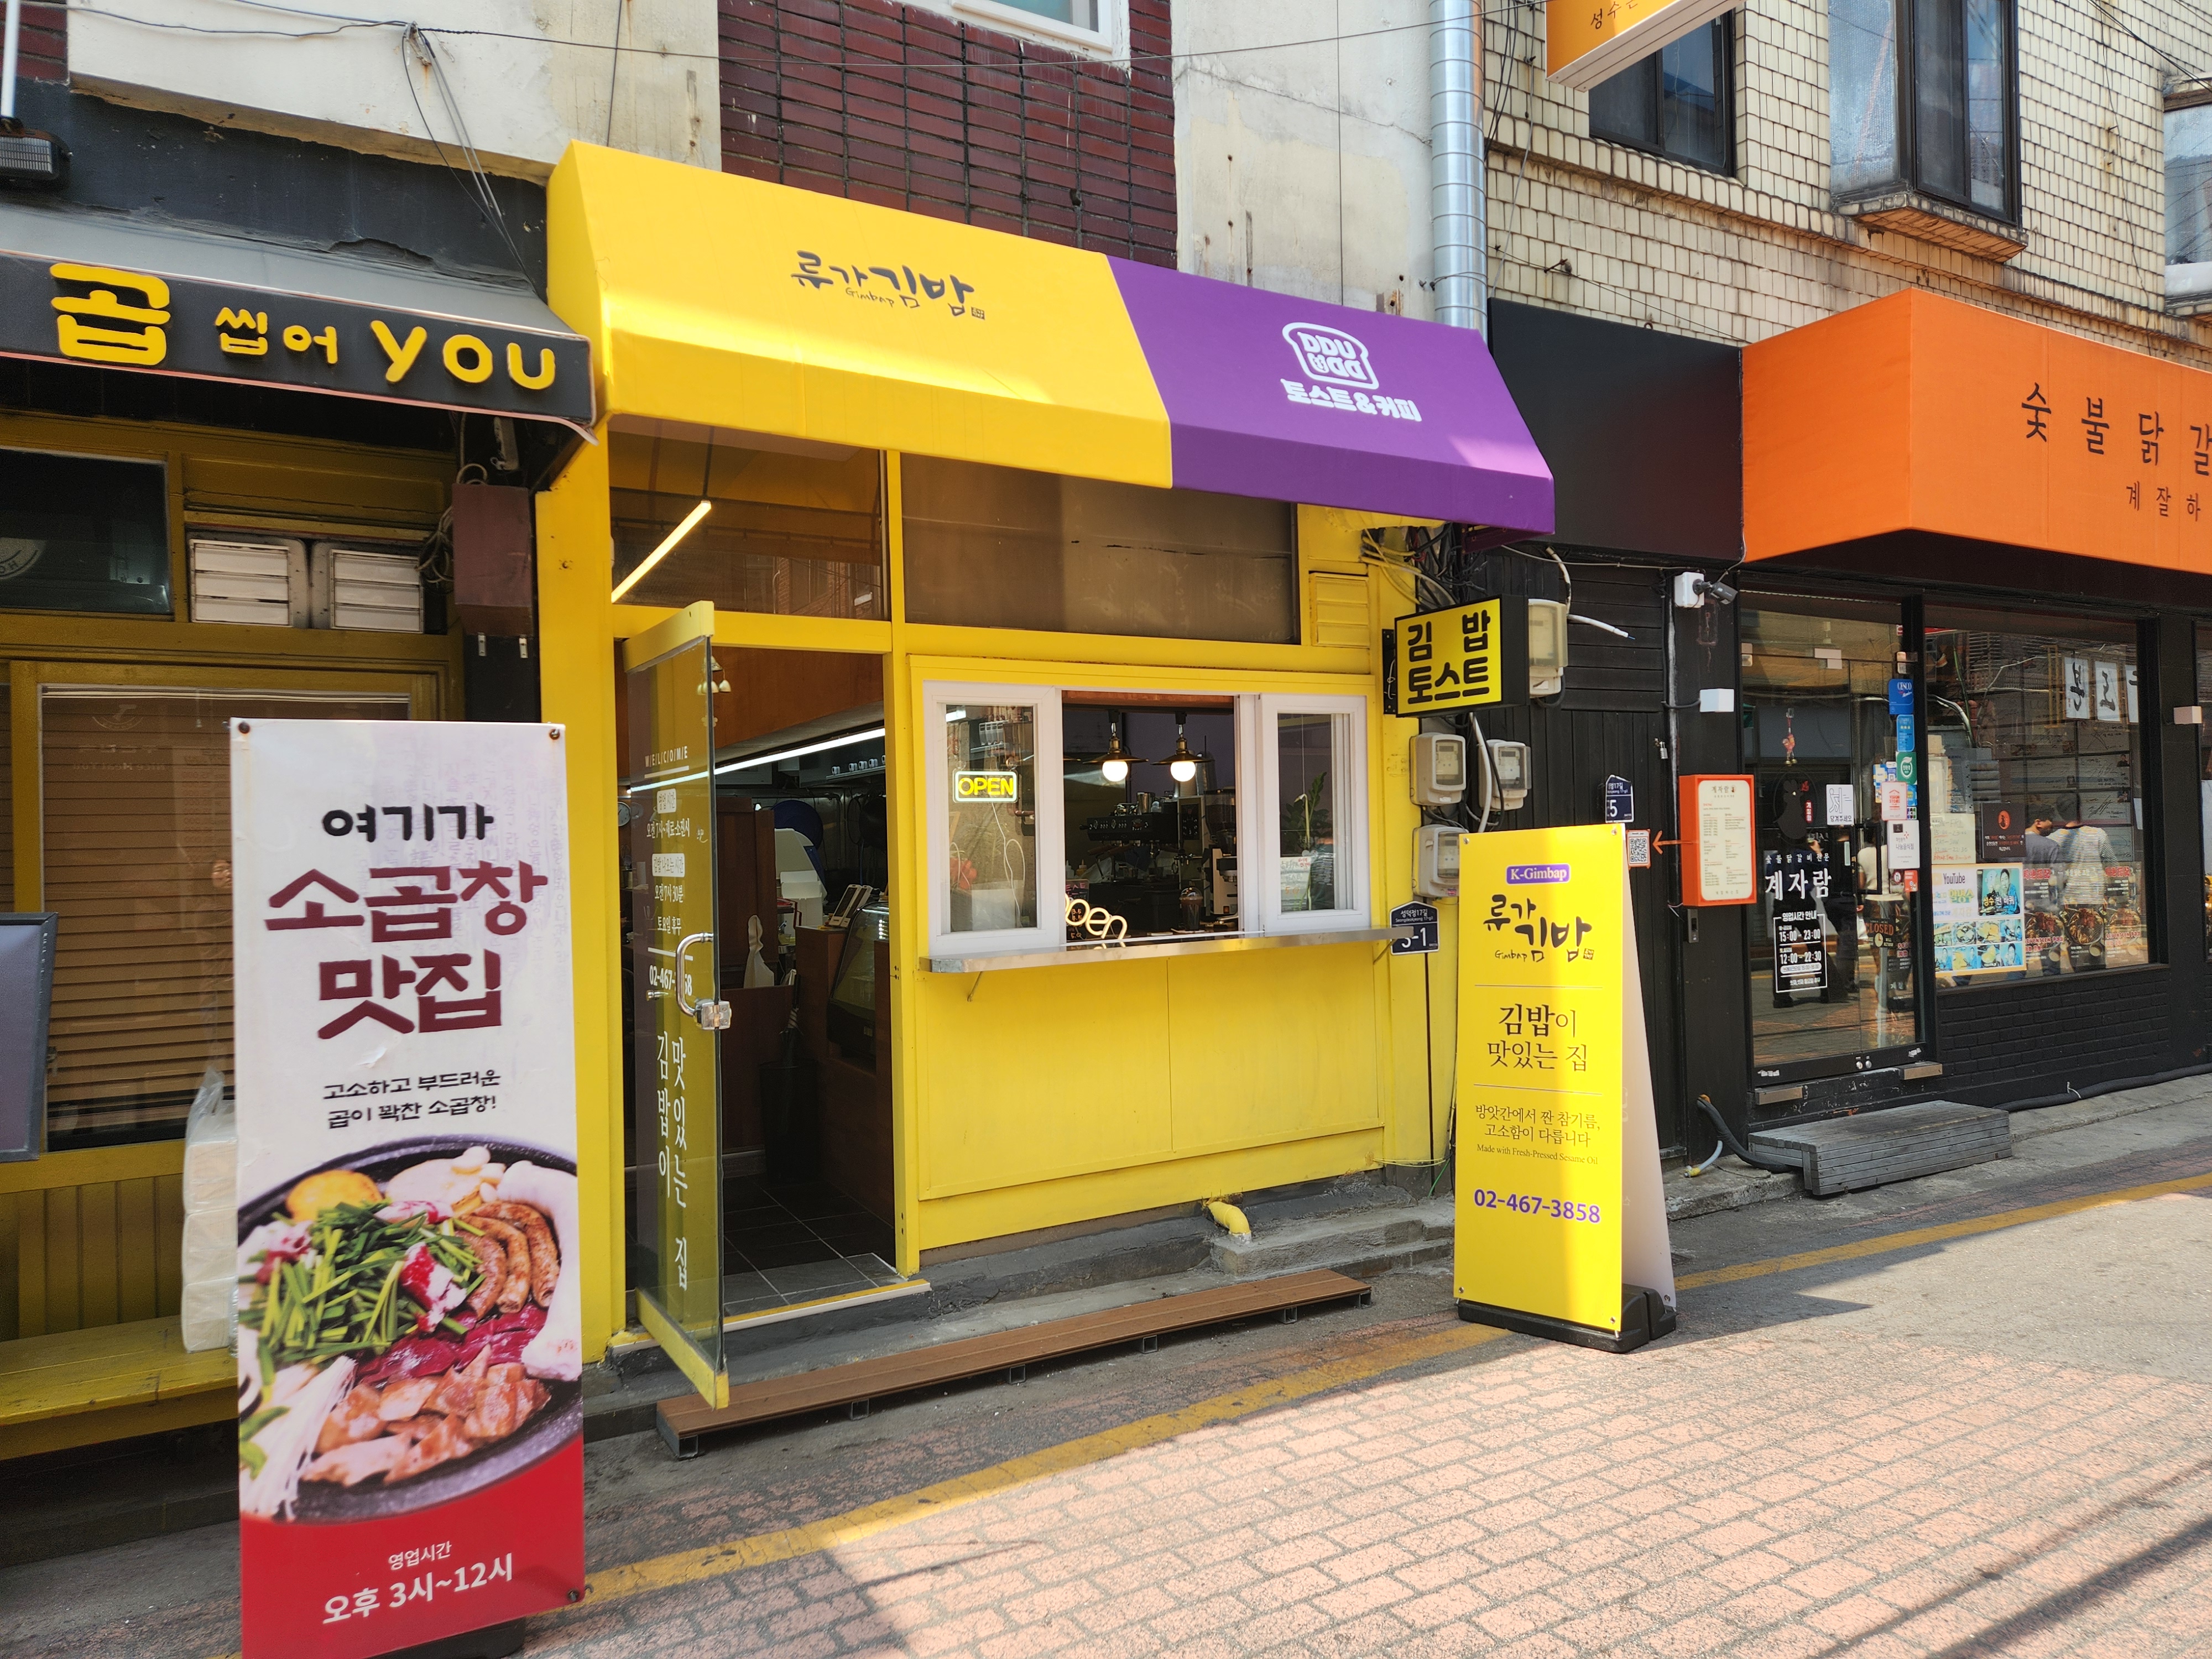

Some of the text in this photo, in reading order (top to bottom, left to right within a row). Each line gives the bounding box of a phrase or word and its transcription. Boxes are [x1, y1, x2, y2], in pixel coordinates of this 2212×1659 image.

[846, 287, 894, 307] Gimbap
[50, 263, 555, 390] 곱 씹어 you
[1297, 332, 1357, 359] DDU
[1407, 609, 1491, 662] 김밥
[1407, 656, 1490, 705] 토스트
[958, 777, 1014, 796] OPEN
[322, 804, 494, 843] 여기가
[1610, 800, 1618, 817] 5
[1510, 867, 1567, 881] K-Gimbap
[1765, 868, 1832, 900] 계자람
[1943, 873, 1965, 884] YouTube
[264, 860, 549, 943] 소곱창
[1400, 909, 1428, 918] 성덕정17길
[1782, 910, 1817, 922] 영업시간 안내
[1984, 896, 1995, 906] 성수
[1779, 930, 1797, 942] 15:00
[1803, 928, 1820, 940] 23:00
[1495, 949, 1528, 962] Gimbap
[1780, 953, 1798, 964] 12:00
[1804, 951, 1822, 962] 22:30
[317, 948, 503, 1040] 맛집
[1499, 1003, 1576, 1038] 김밥이
[1487, 1040, 1587, 1072] 맛있는 집
[323, 1069, 502, 1099] 고소하고 부드러운
[328, 1097, 373, 1129] 곱이
[428, 1095, 497, 1117] 소곱창!
[657, 1030, 671, 1199] 김밥이
[1475, 1104, 1601, 1131] 방앗간에서 짠 참기름,
[1484, 1123, 1591, 1148] 고소함이 다릅니다
[671, 1036, 688, 1292] 맛있는 집
[1477, 1144, 1495, 1153] Made
[1496, 1146, 1511, 1155] with
[1512, 1147, 1558, 1160] Fresh-Pressed
[1559, 1154, 1585, 1163] Sesame
[1474, 1188, 1600, 1223] 02-467-3858
[388, 1541, 452, 1571] 영업시간
[322, 1552, 513, 1625] 오후 3시~12시
